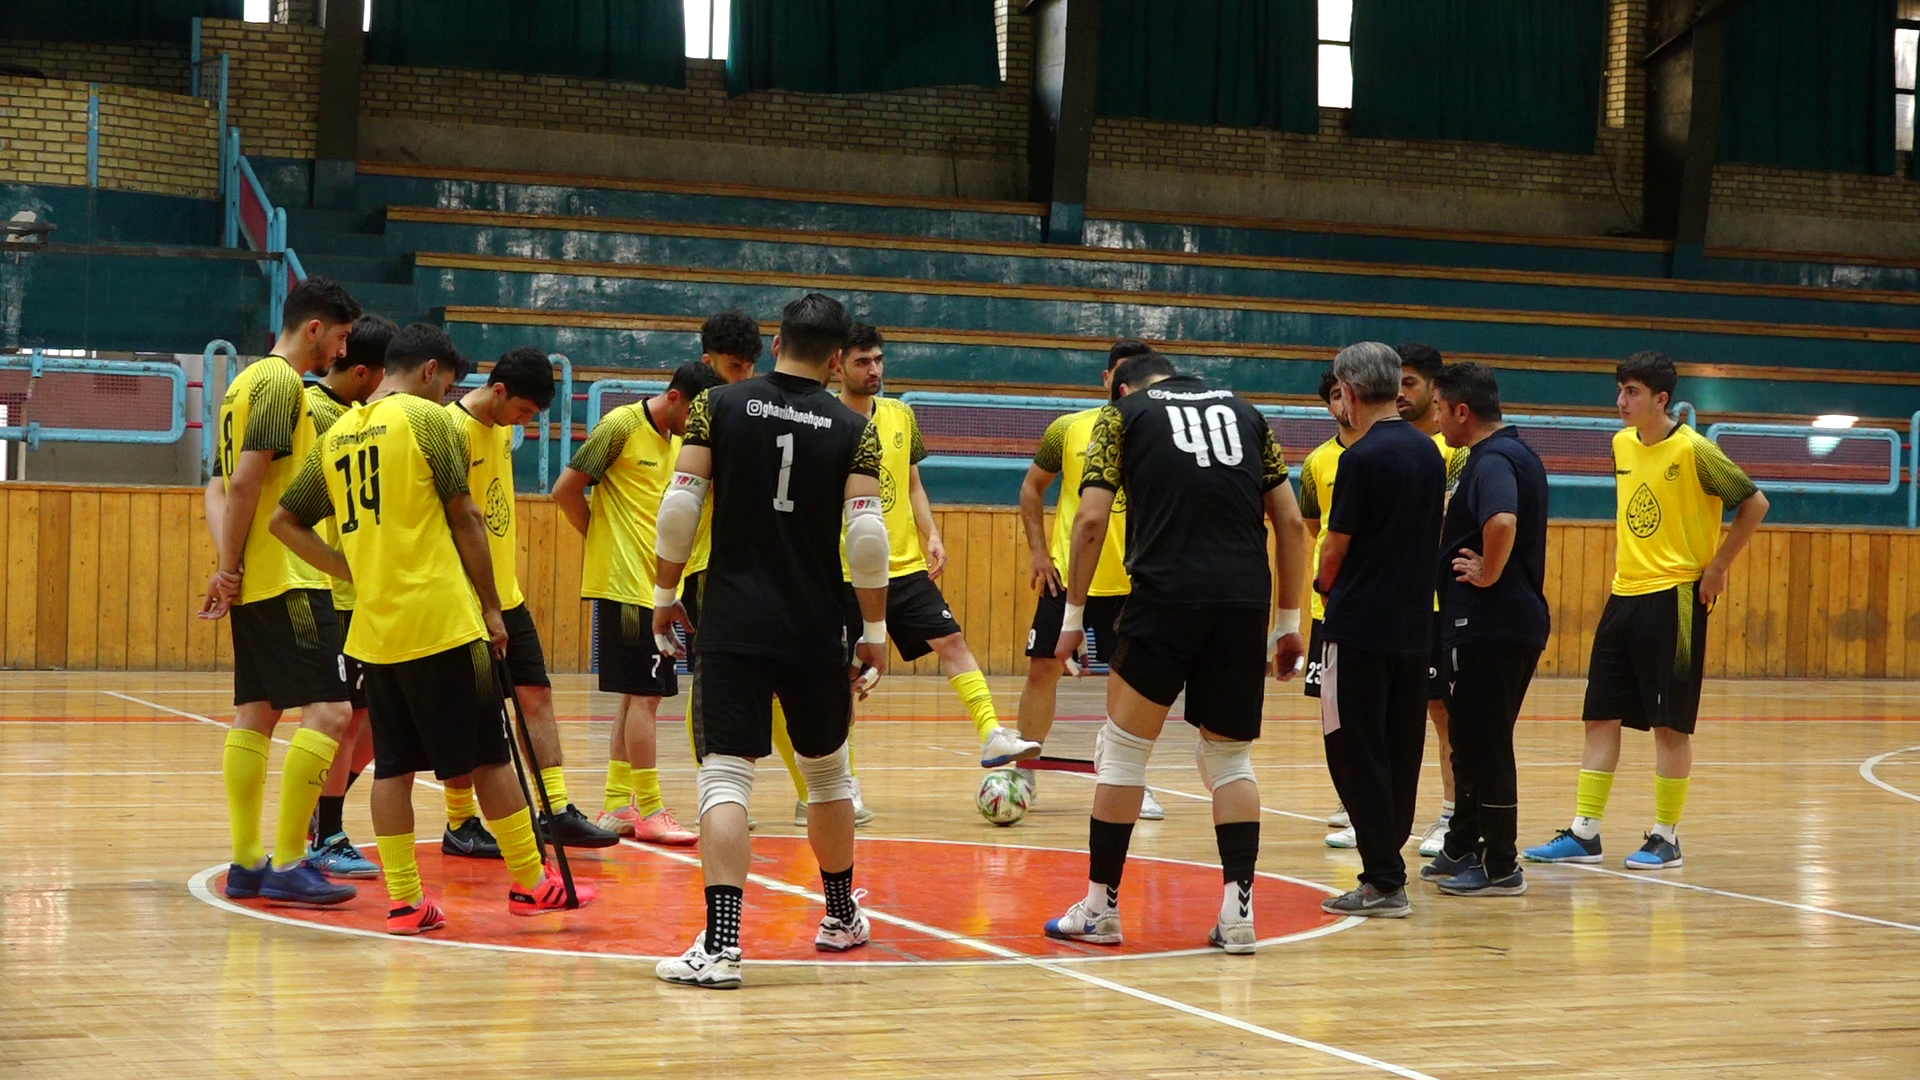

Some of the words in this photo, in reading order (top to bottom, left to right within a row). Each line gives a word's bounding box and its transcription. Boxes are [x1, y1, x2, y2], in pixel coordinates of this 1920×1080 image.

[1165, 404, 1244, 468] 40
[773, 432, 795, 513] 1
[335, 445, 381, 534] 14
[1027, 628, 1036, 650] 9
[337, 653, 347, 683] 8
[652, 654, 661, 679] 7
[1306, 661, 1322, 685] 23
